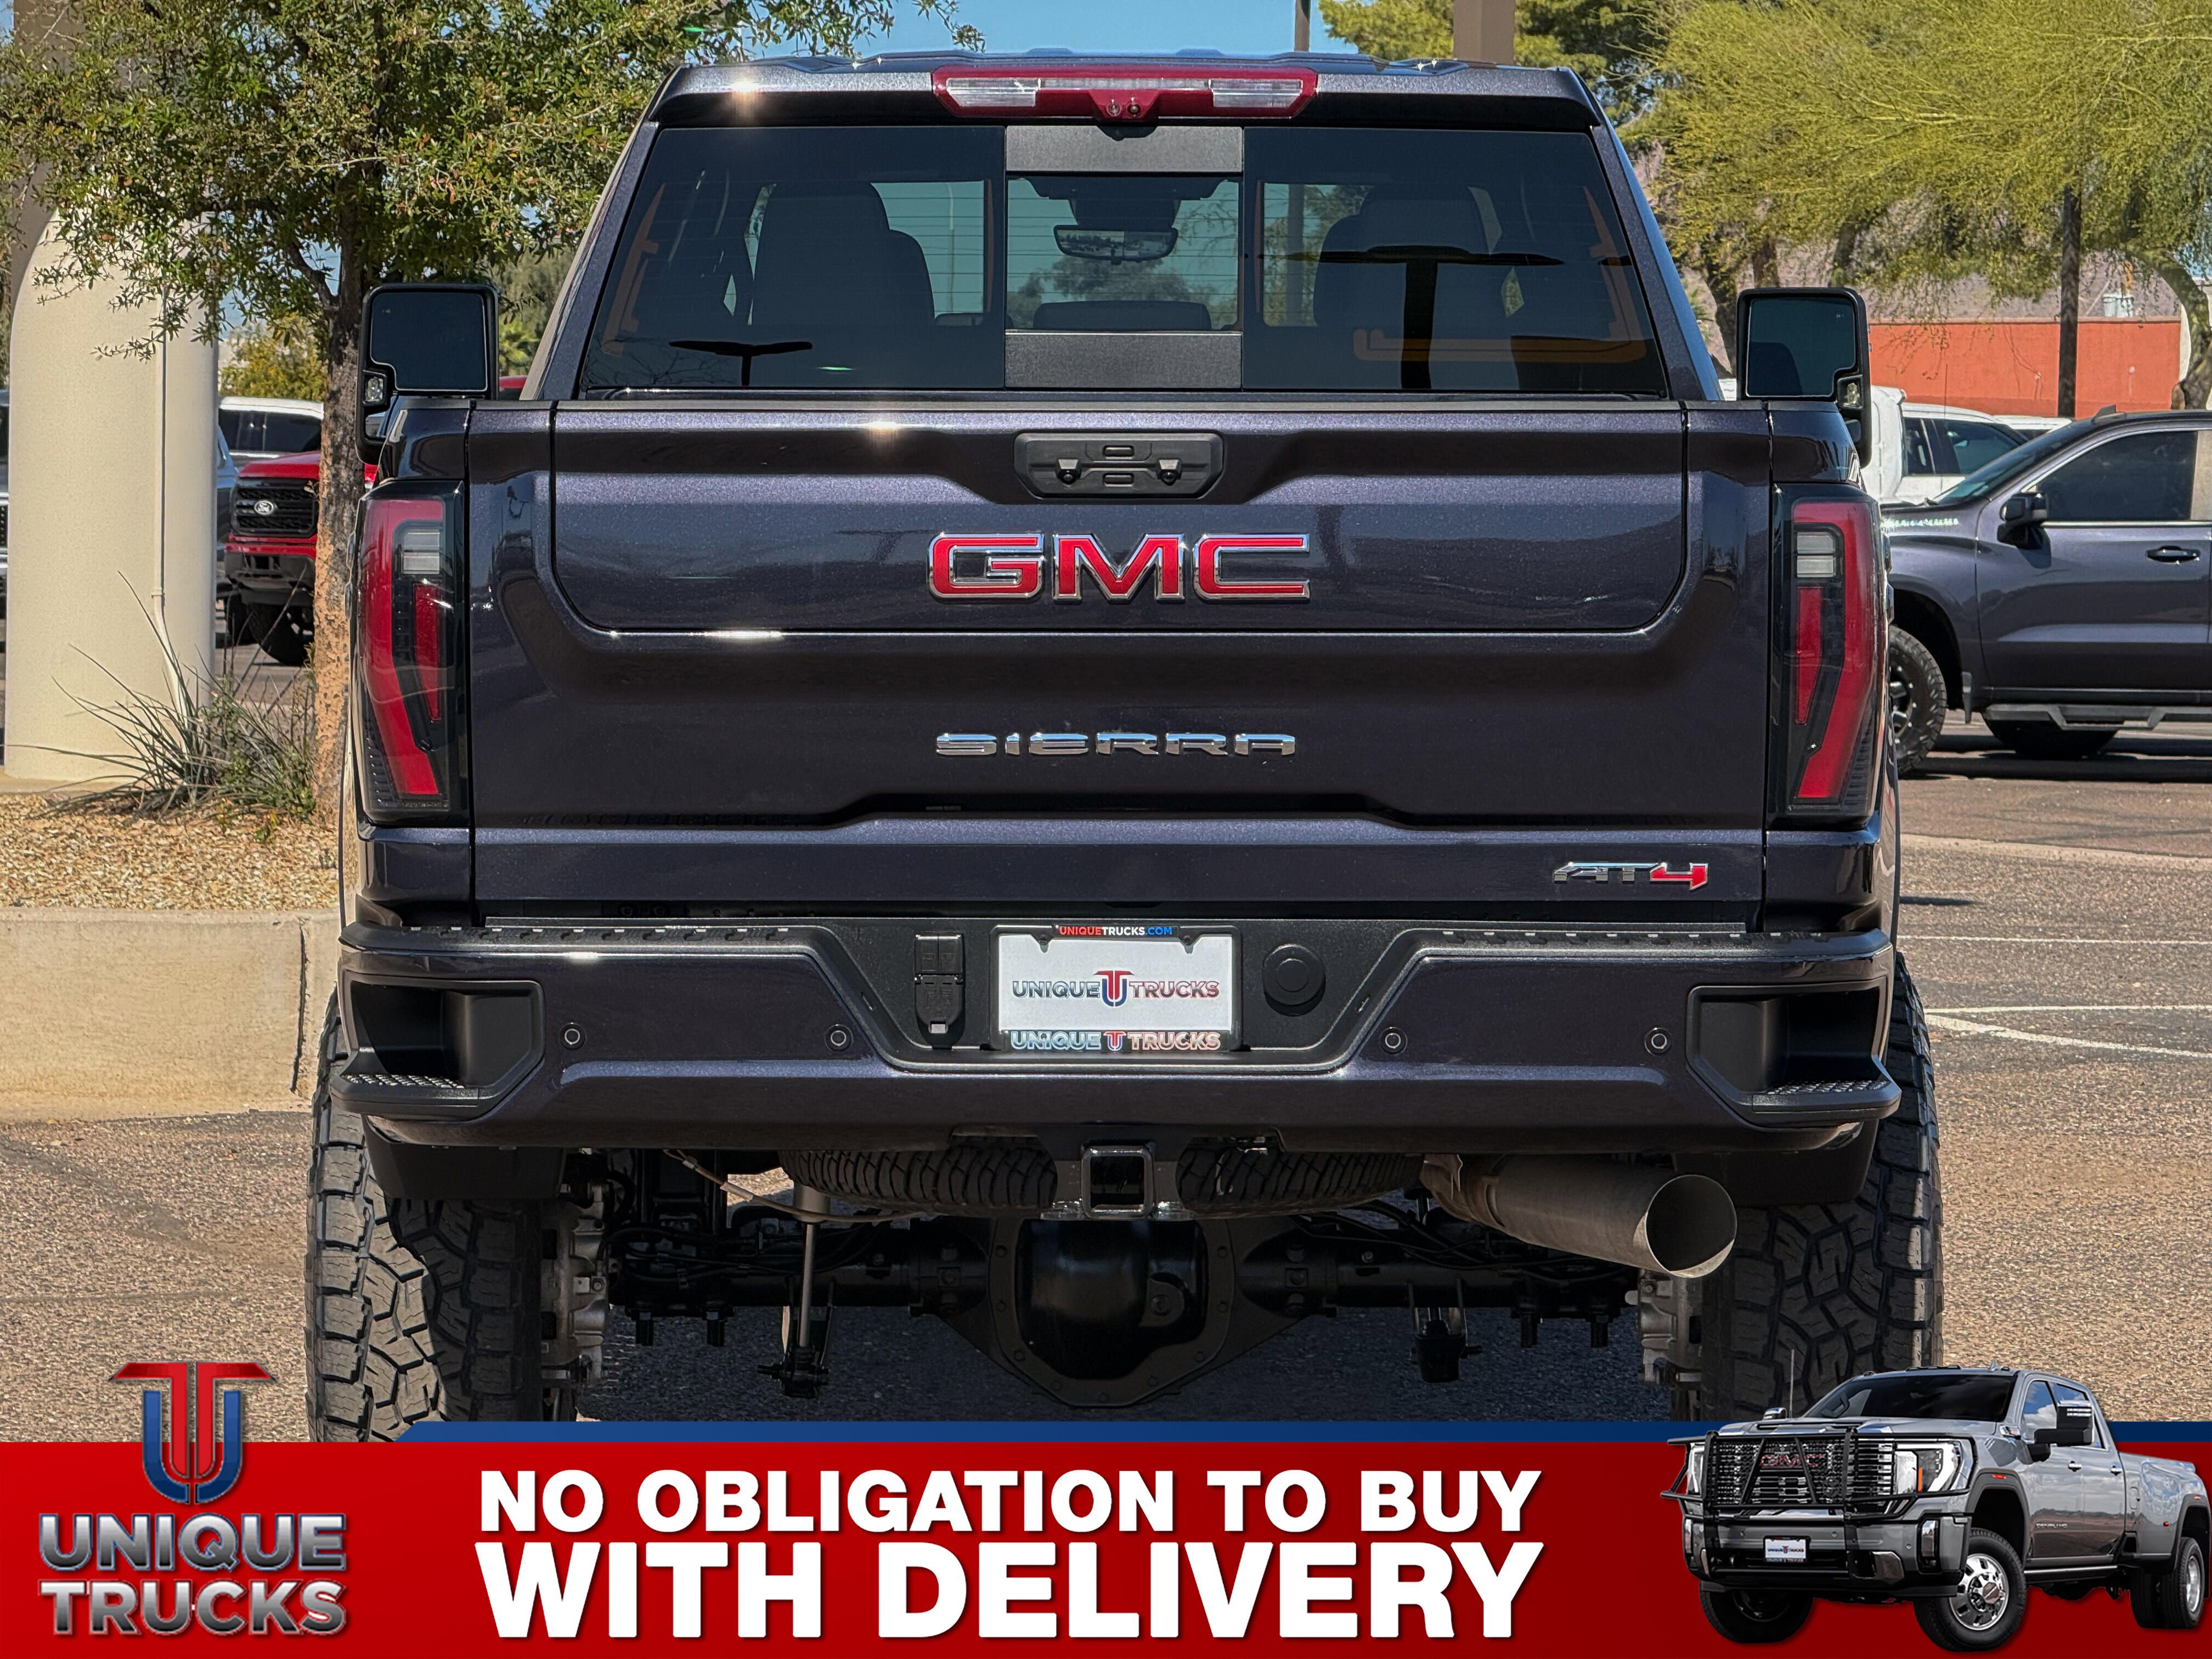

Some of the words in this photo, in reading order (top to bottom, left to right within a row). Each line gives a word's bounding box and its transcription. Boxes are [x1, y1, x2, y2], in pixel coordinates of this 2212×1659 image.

[928, 532, 1311, 602] GMC
[936, 732, 1296, 756] SIERRA
[1553, 861, 1708, 890] AT4
[1059, 926, 1172, 936] UNIQUETRUCKS.COM
[1012, 980, 1101, 998] UNIQUE
[1129, 980, 1220, 998] TRUCKS
[1011, 1031, 1101, 1051] UNIQUE
[1127, 1031, 1221, 1051] TRUCKS
